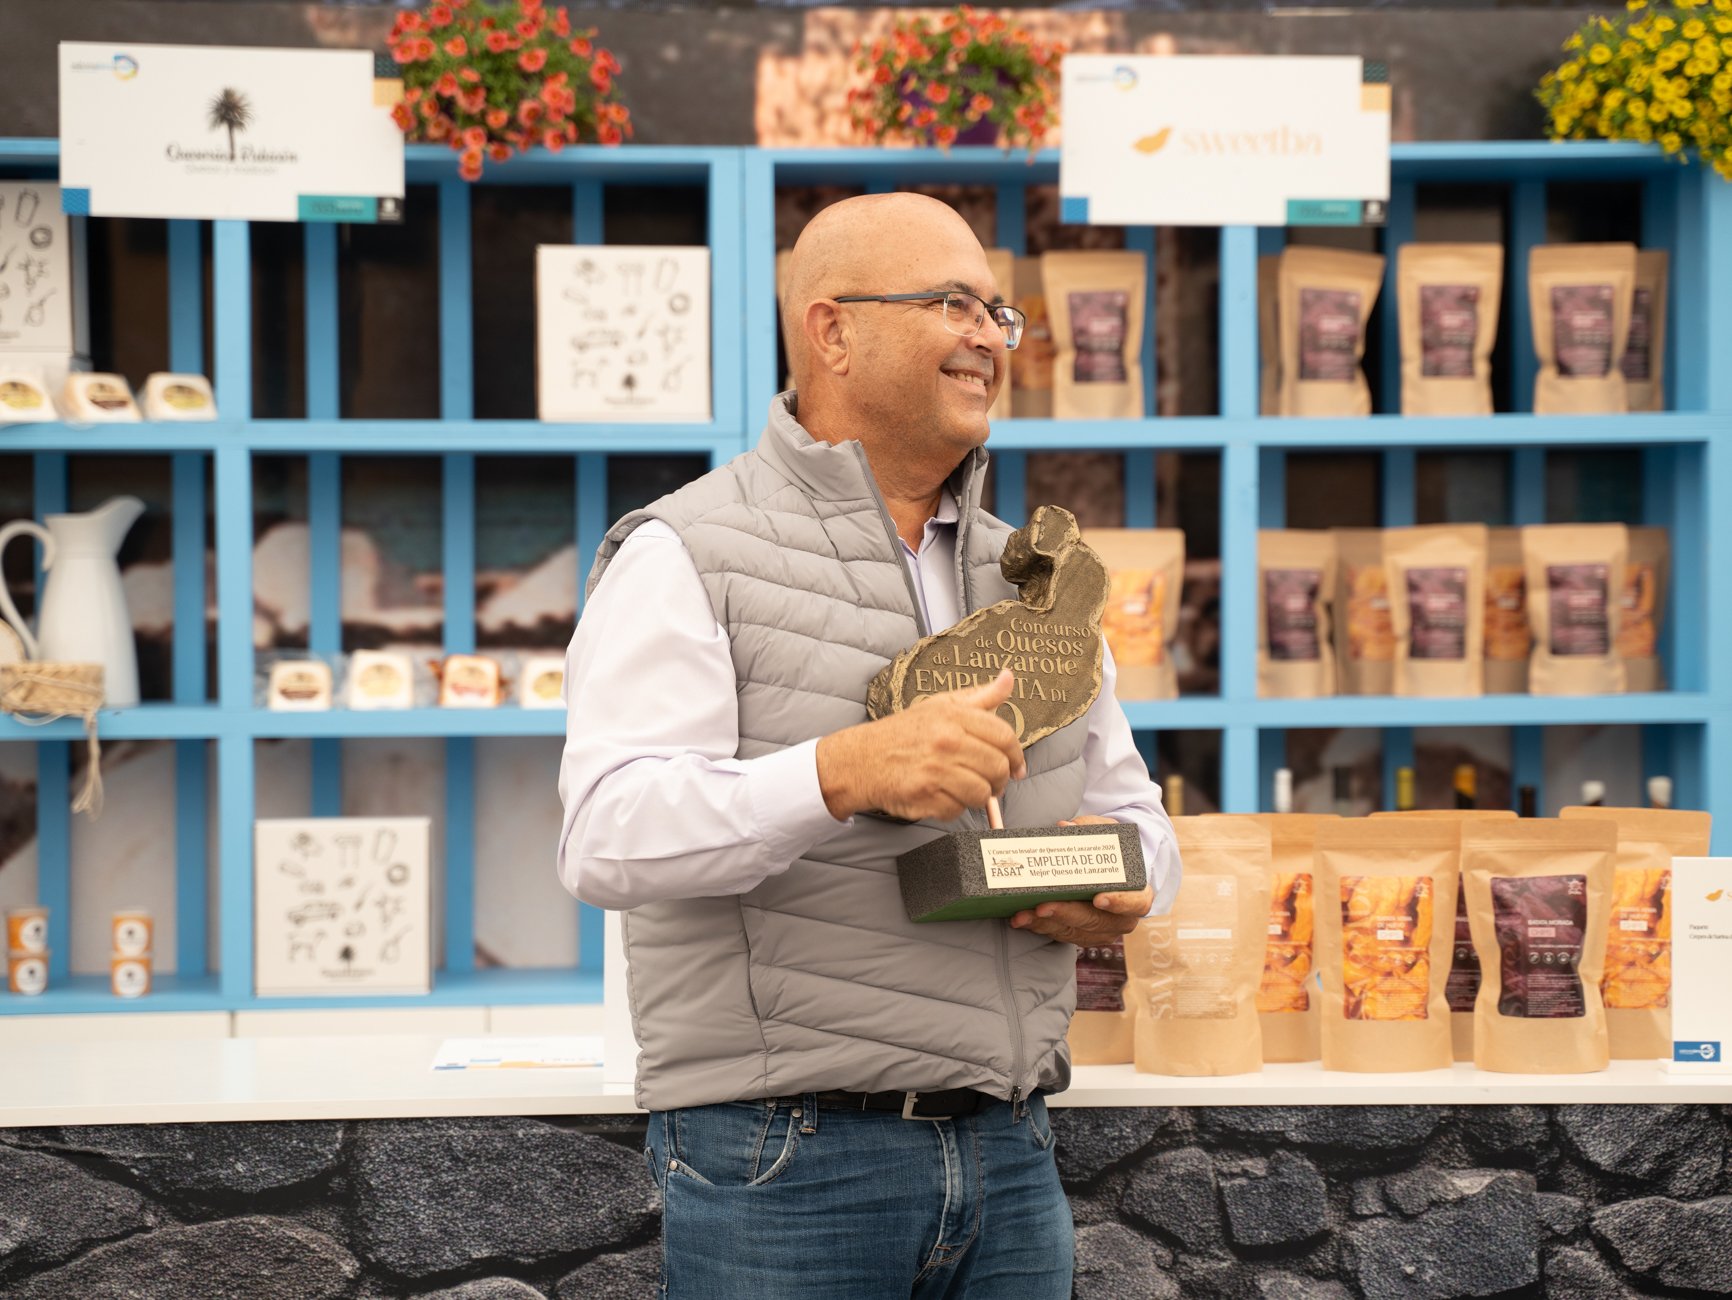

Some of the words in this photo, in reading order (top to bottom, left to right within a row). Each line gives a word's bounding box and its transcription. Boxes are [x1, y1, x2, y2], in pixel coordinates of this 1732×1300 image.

[1010, 616, 1092, 639] Concurso
[975, 635, 993, 649] de
[996, 629, 1085, 658] Quesos
[933, 652, 950, 667] de
[952, 644, 1078, 676] Lanzarote
[914, 668, 1047, 702] EMPTA
[991, 866, 1022, 877] FASAT
[1026, 855, 1078, 868] EMPLEITA
[1079, 854, 1094, 865] DE
[1095, 853, 1118, 865] ORO
[1029, 869, 1051, 878] Mejor
[1051, 868, 1073, 877] Queso
[1074, 867, 1083, 875] de
[1083, 866, 1120, 875] Lanzarote
